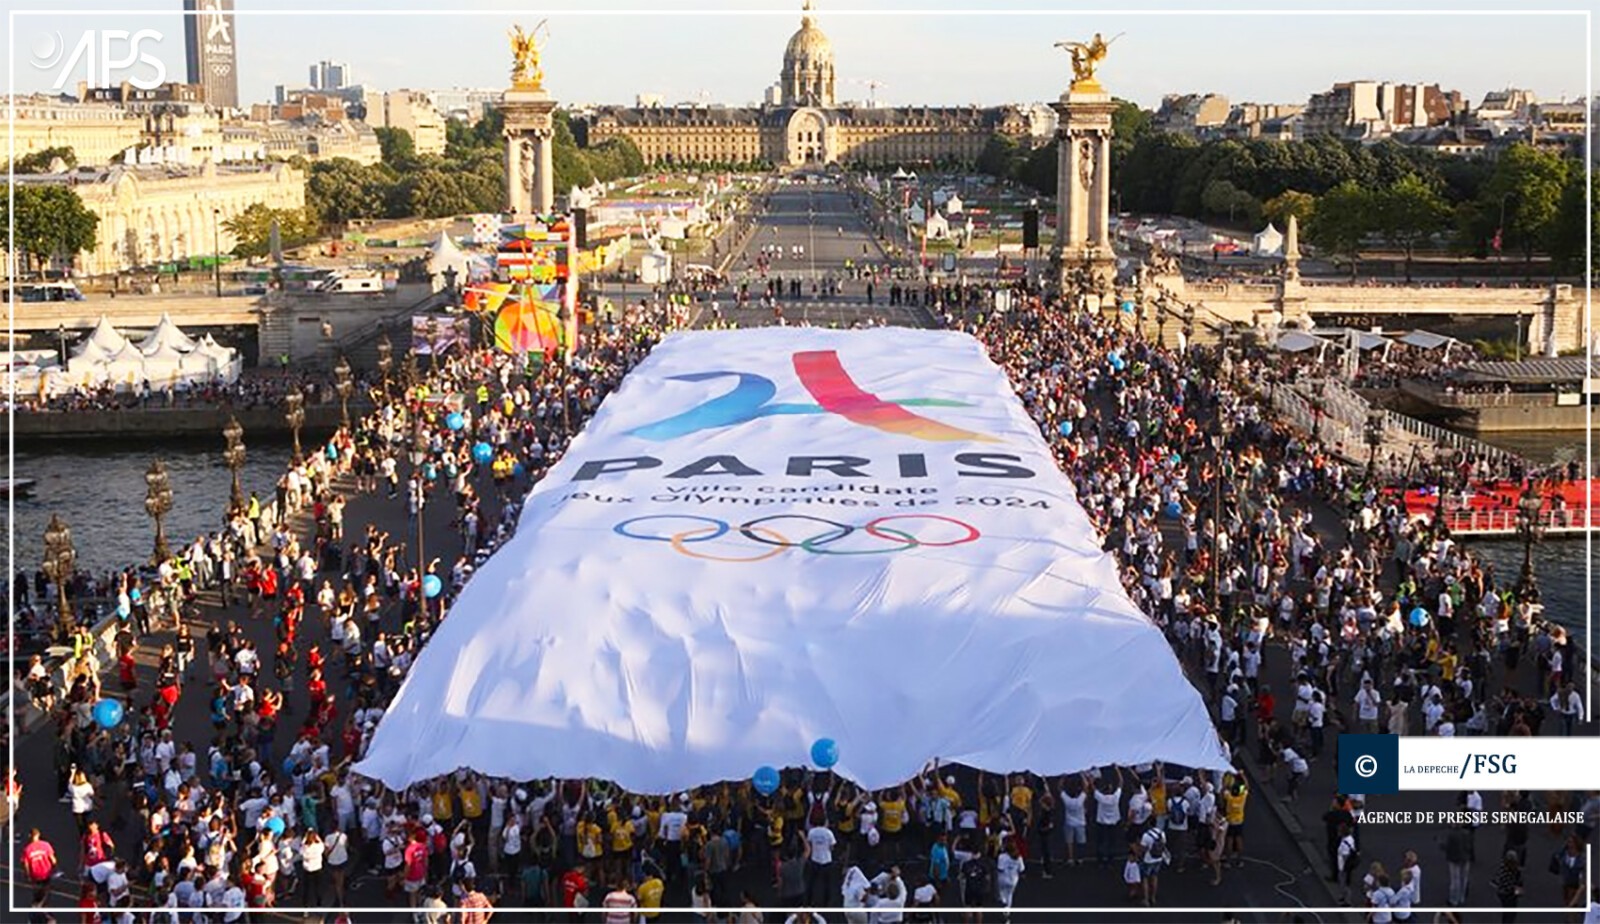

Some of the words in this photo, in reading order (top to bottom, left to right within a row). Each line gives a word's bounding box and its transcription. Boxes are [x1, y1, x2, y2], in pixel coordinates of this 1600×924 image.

[571, 453, 1036, 481] PARIS
[757, 484, 938, 495] candidate
[651, 494, 879, 507] Olympiques
[894, 498, 939, 507] de
[955, 496, 1051, 510] 2024
